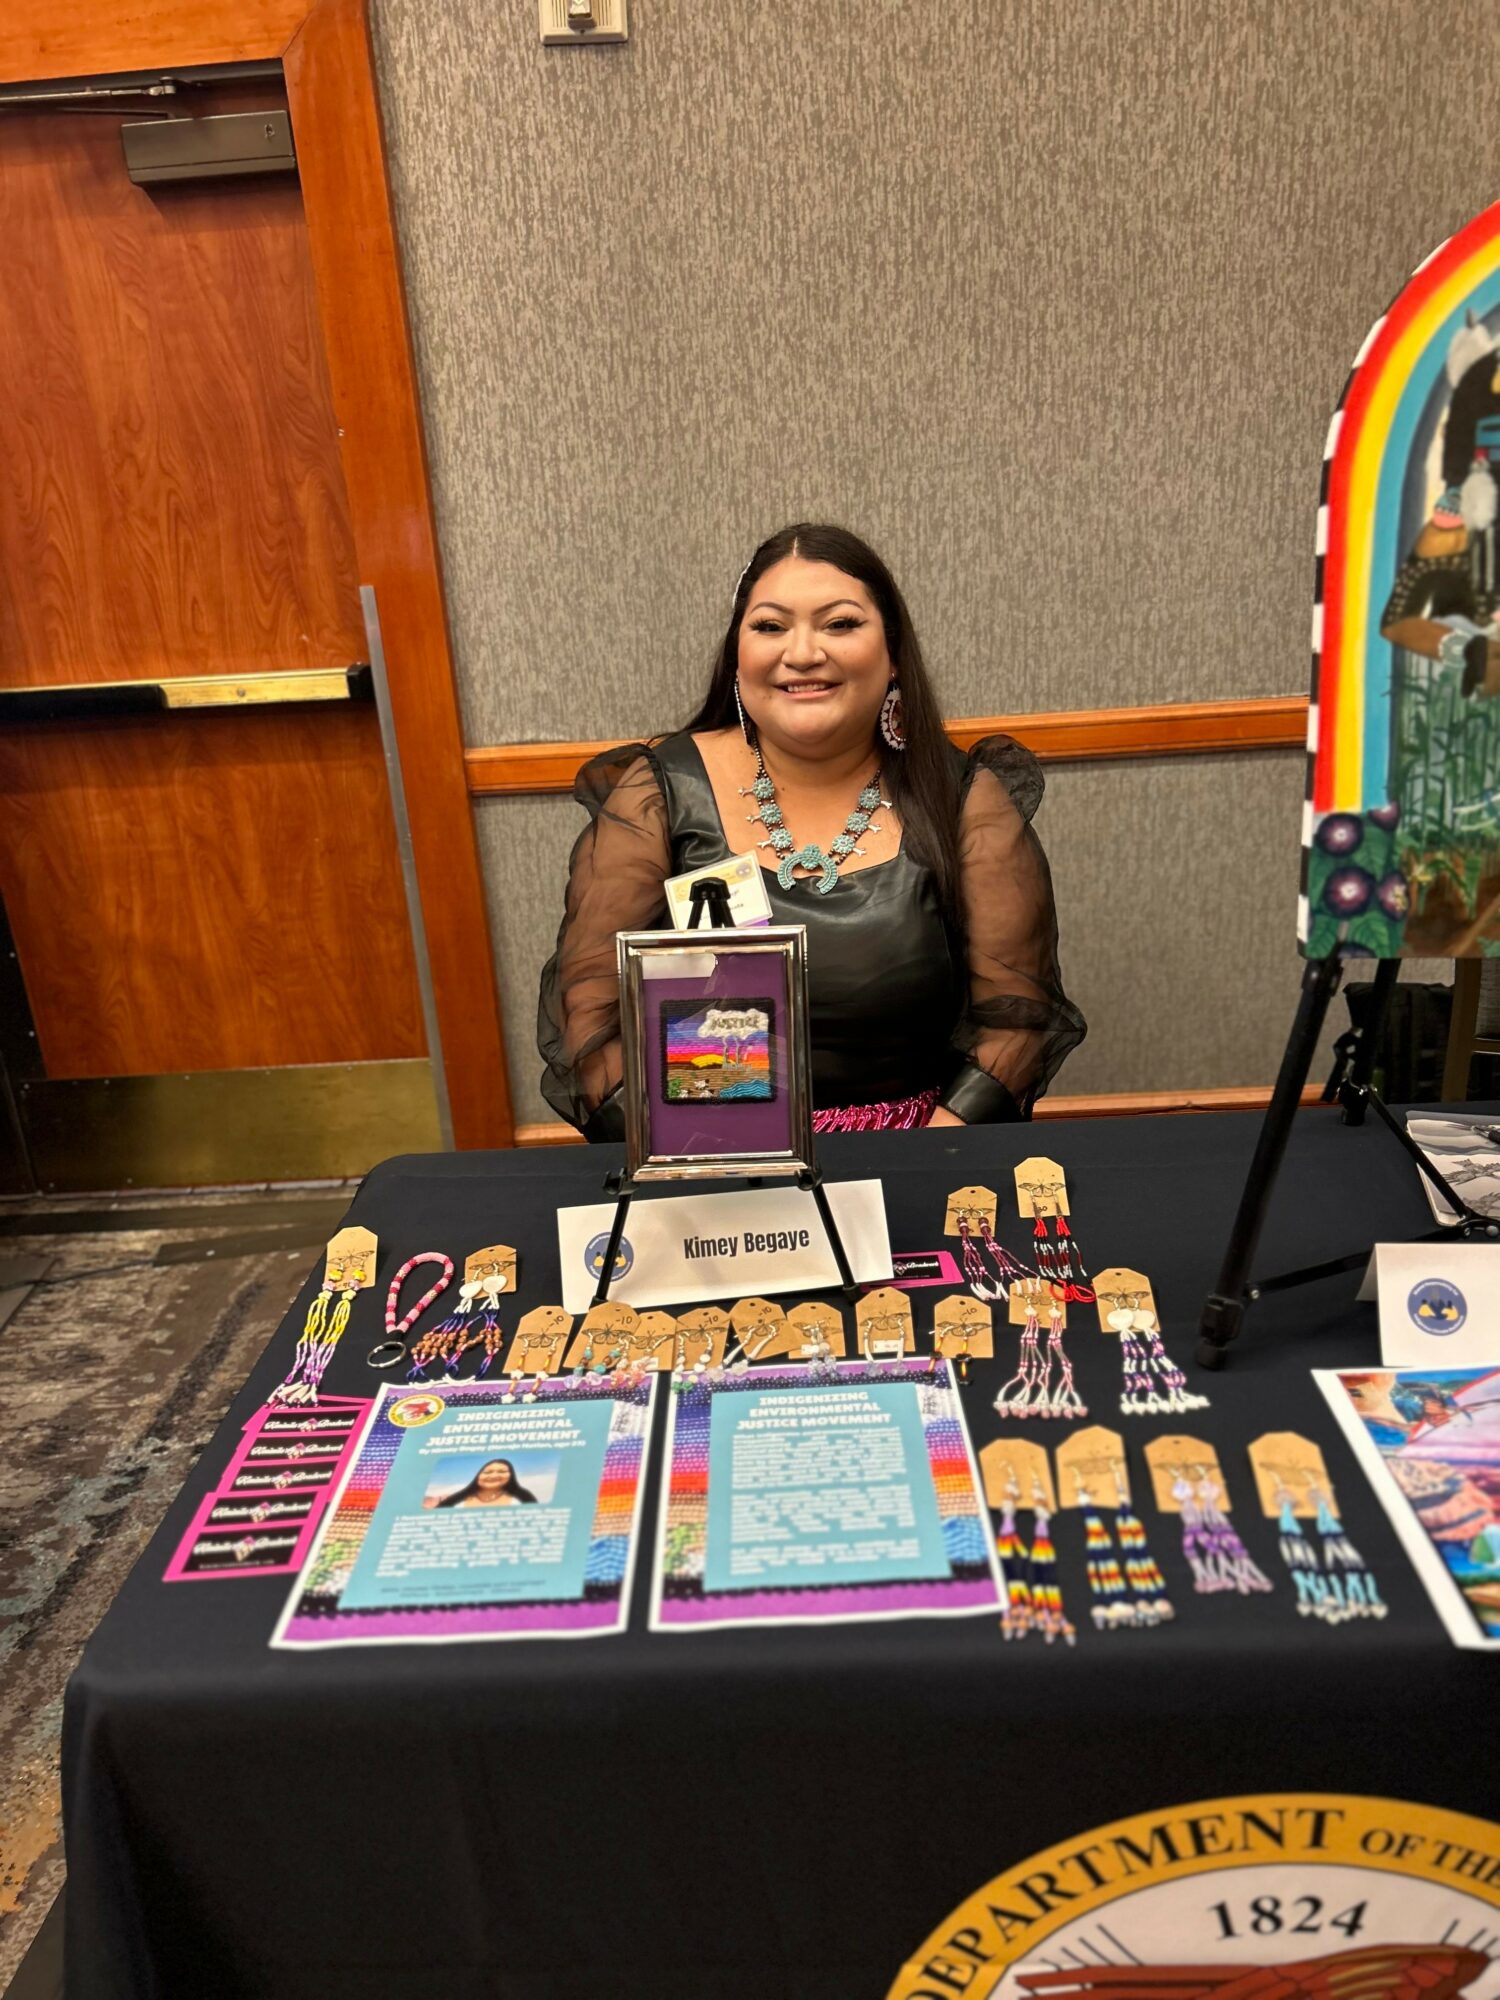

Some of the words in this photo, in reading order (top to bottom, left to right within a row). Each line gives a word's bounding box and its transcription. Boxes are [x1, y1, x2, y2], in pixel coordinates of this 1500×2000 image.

[684, 1236, 738, 1259] Kimey
[743, 1229, 810, 1254] Begaye
[759, 1391, 869, 1406] INDIGENIZING
[456, 1407, 566, 1422] INDIGENIZING
[749, 1402, 881, 1417] ENVIRONMENTAL
[443, 1419, 574, 1434] ENVIRONMENTAL
[736, 1418, 799, 1430] JUSTICE
[801, 1413, 892, 1426] MOVEMENT
[426, 1434, 489, 1446] JUSTICE
[490, 1430, 581, 1443] MOVEMENT
[1360, 1827, 1427, 1858] OF
[1206, 1895, 1370, 1941] 1824
